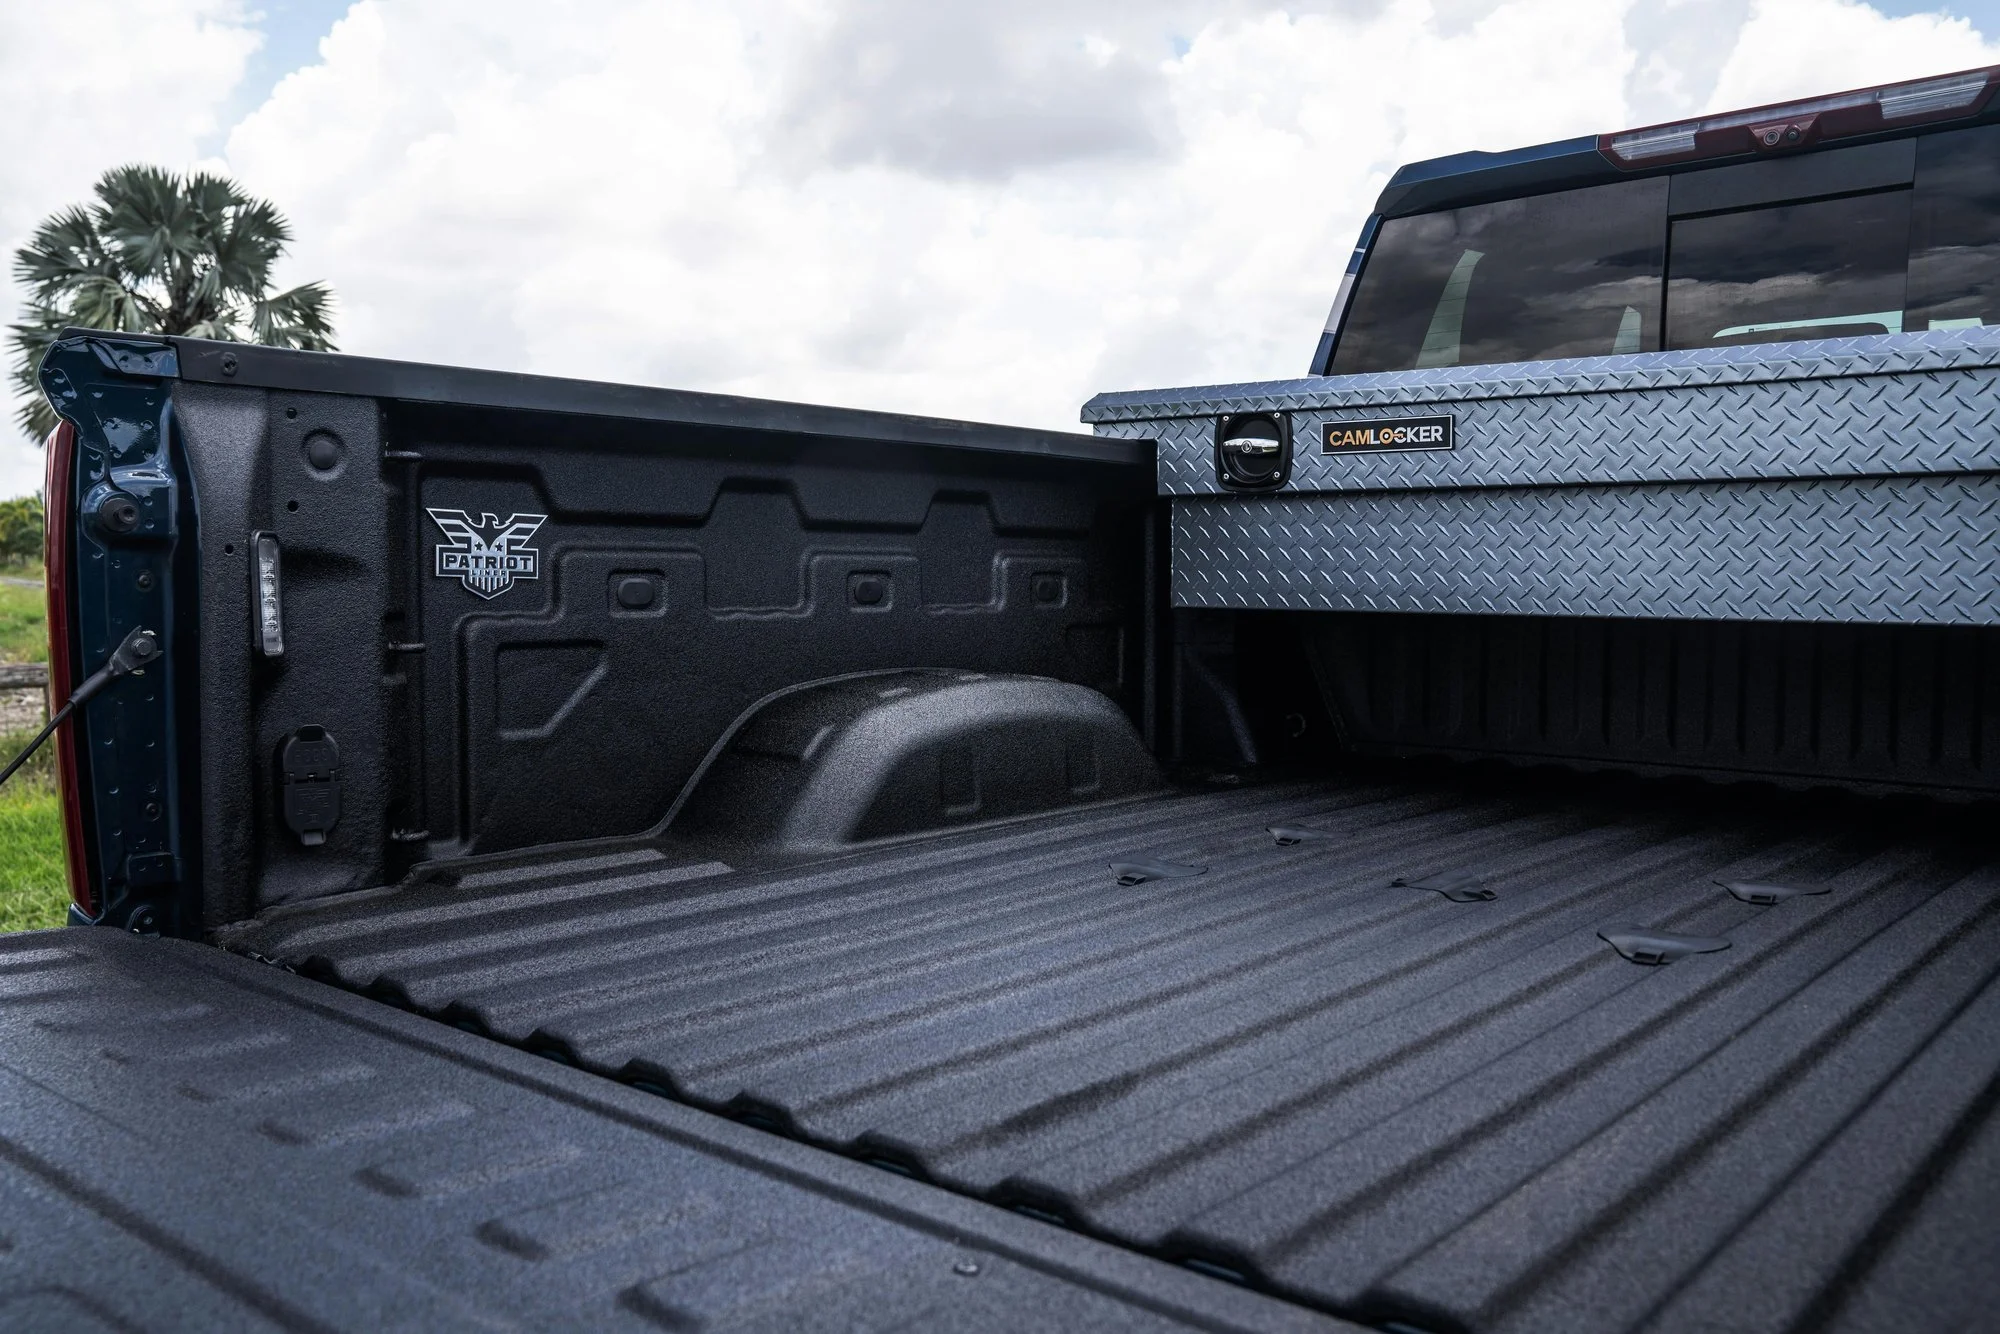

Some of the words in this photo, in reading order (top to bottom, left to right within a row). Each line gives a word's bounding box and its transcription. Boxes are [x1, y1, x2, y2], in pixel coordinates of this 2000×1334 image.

[1329, 425, 1444, 447] CAMLOCKER
[445, 554, 531, 570] PATRIOT
[471, 569, 507, 577] LINER
